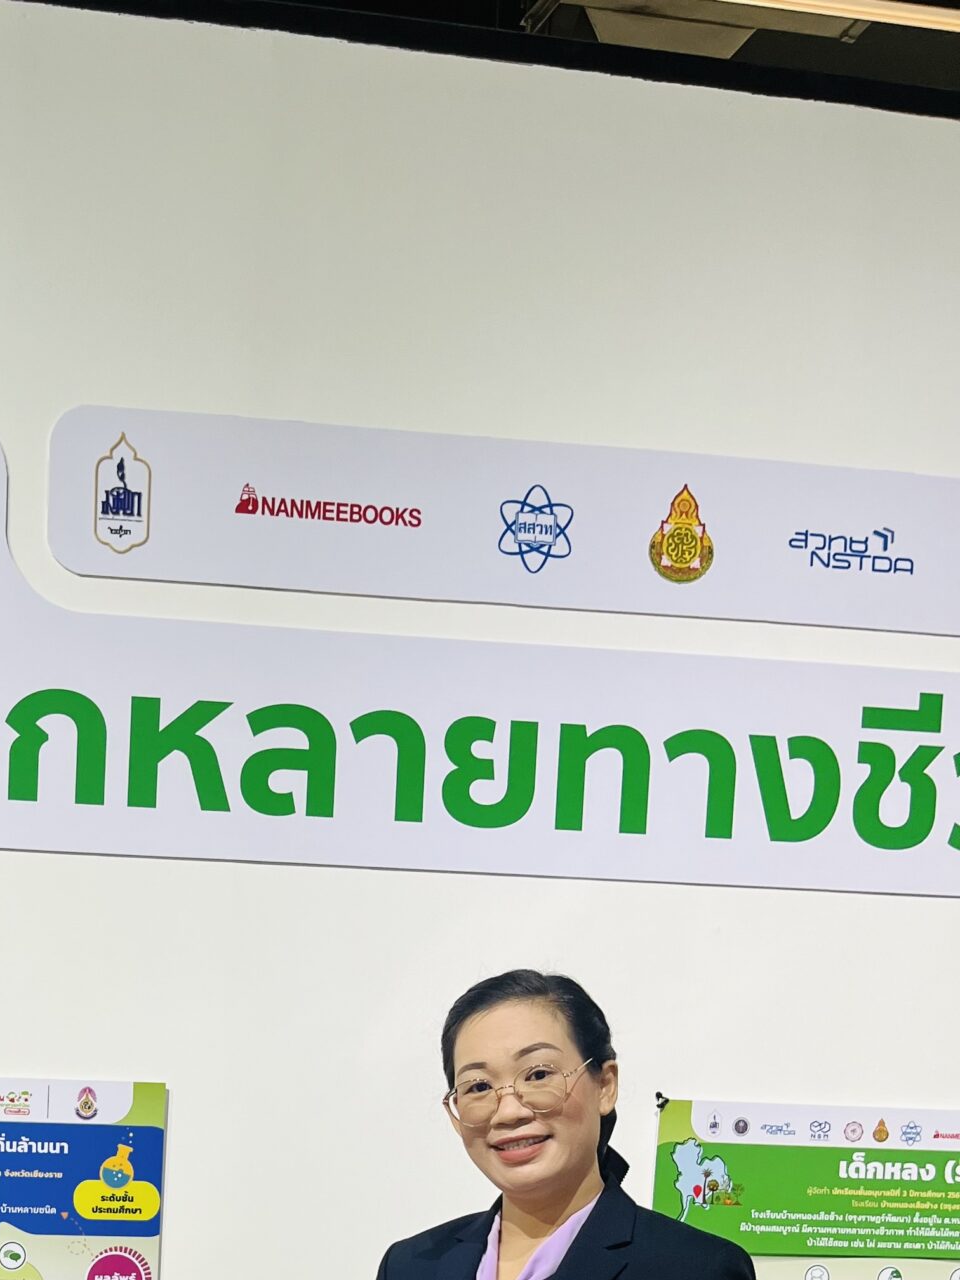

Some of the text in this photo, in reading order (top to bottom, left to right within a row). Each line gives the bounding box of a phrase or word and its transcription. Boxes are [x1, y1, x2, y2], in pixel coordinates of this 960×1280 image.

[260, 496, 423, 529] NANMEEBOOKS
[517, 520, 553, 537] สสวท
[809, 550, 914, 575] NSTDA
[838, 1151, 937, 1182] เด็กหลง
